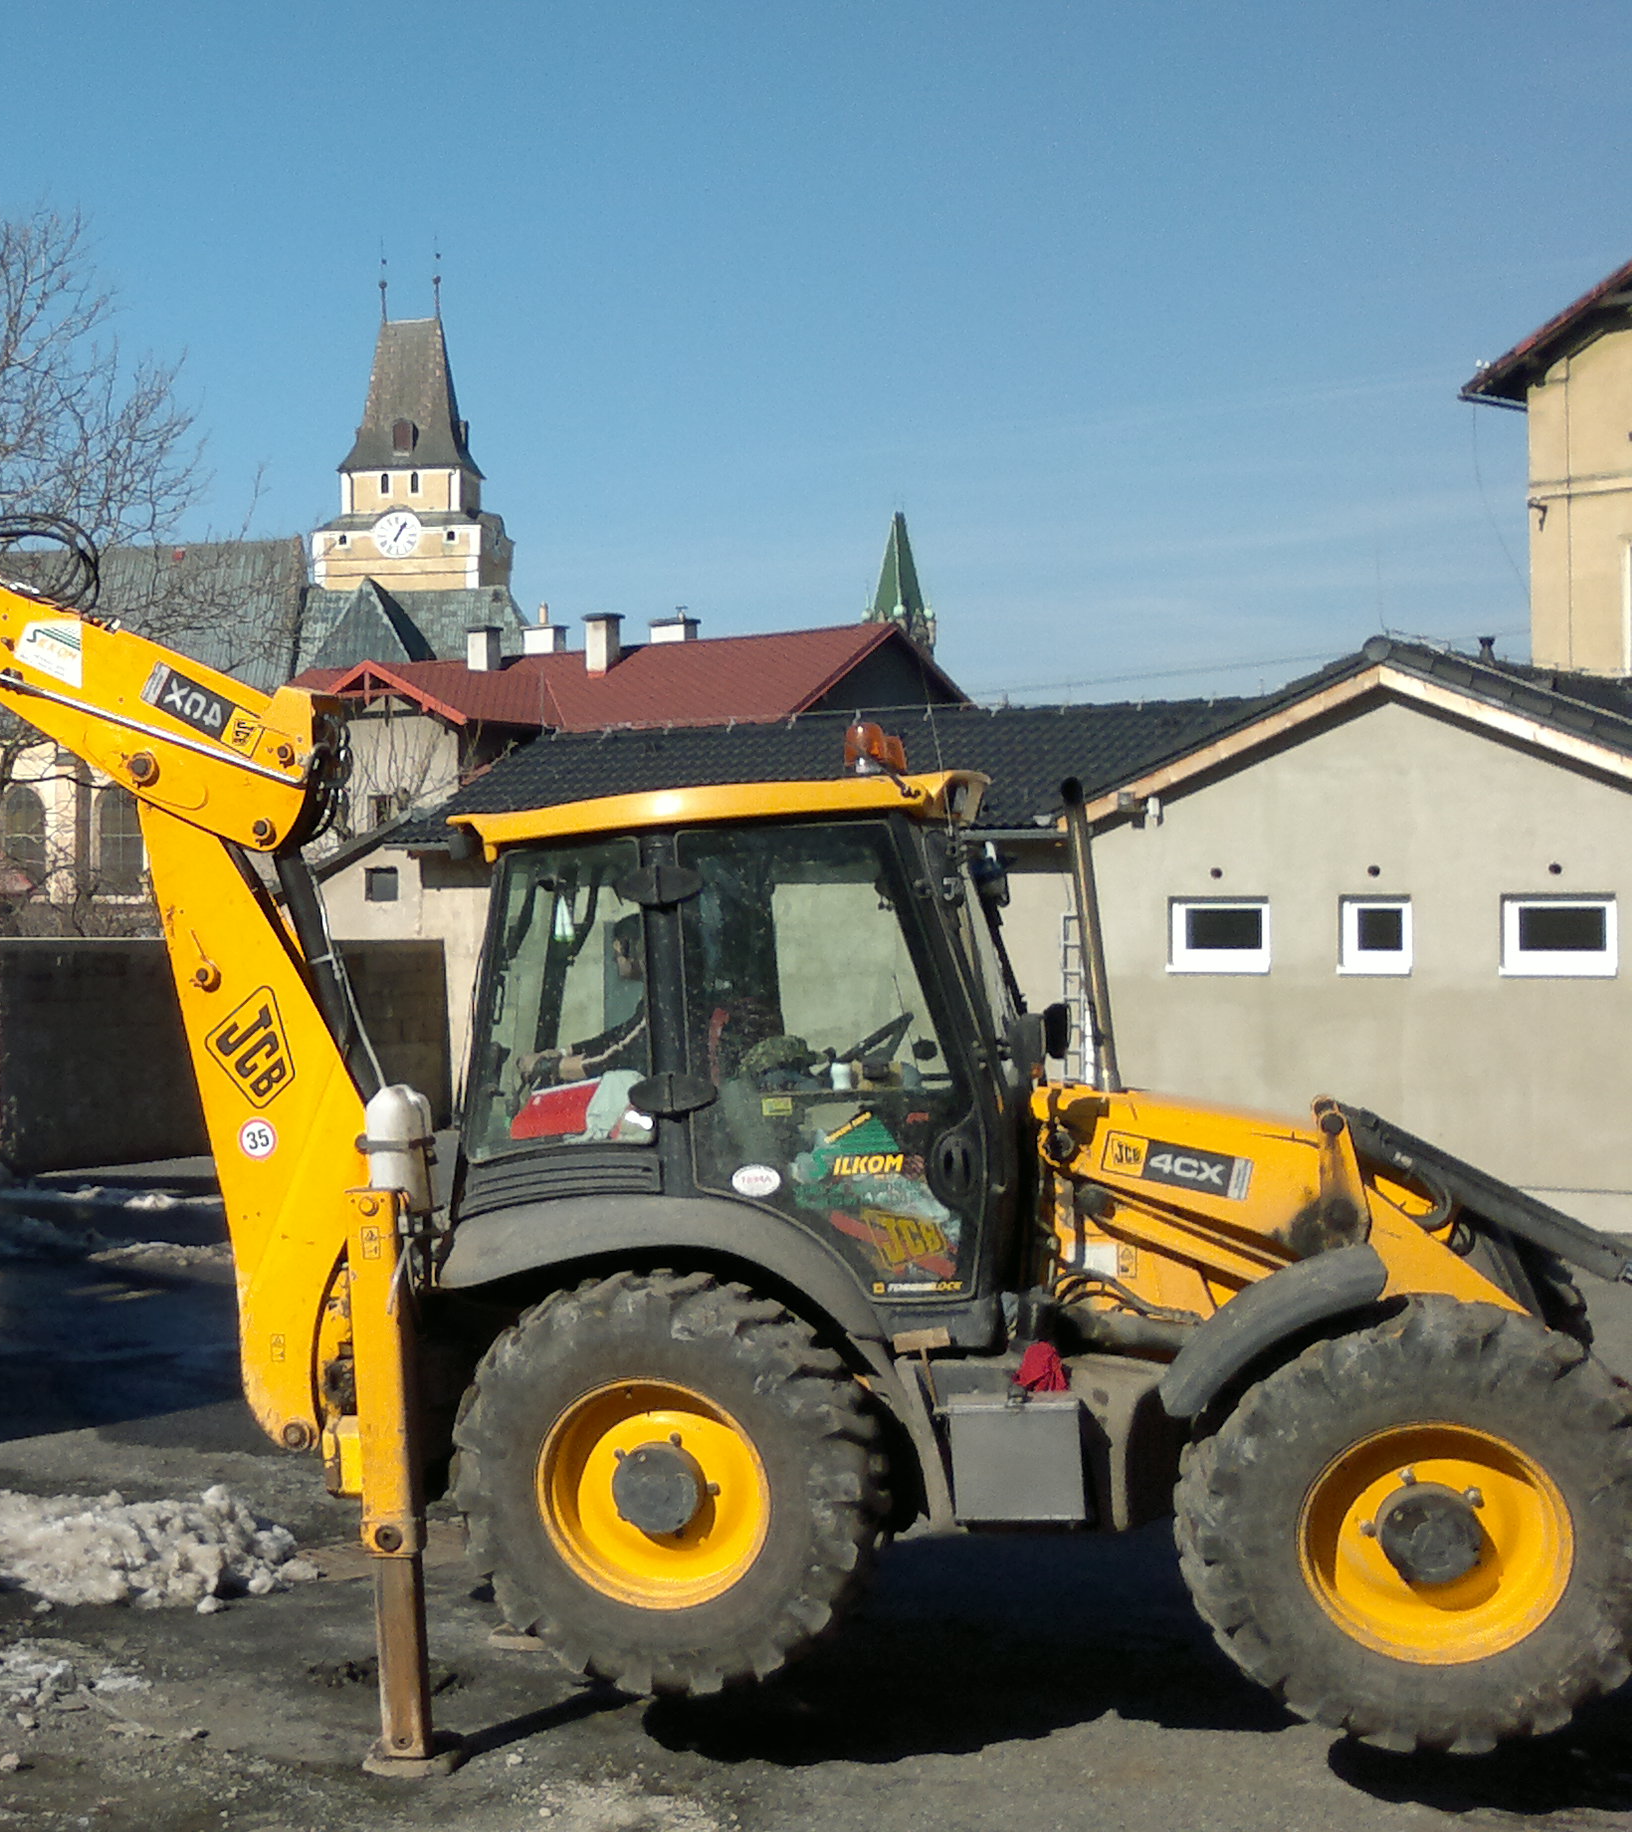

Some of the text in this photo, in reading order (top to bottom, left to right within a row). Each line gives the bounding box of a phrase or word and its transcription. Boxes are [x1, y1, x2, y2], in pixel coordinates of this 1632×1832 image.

[216, 1003, 286, 1098] JCB
[246, 1128, 270, 1150] 35
[1149, 1153, 1226, 1186] 4CX
[876, 1214, 943, 1263] JCB
